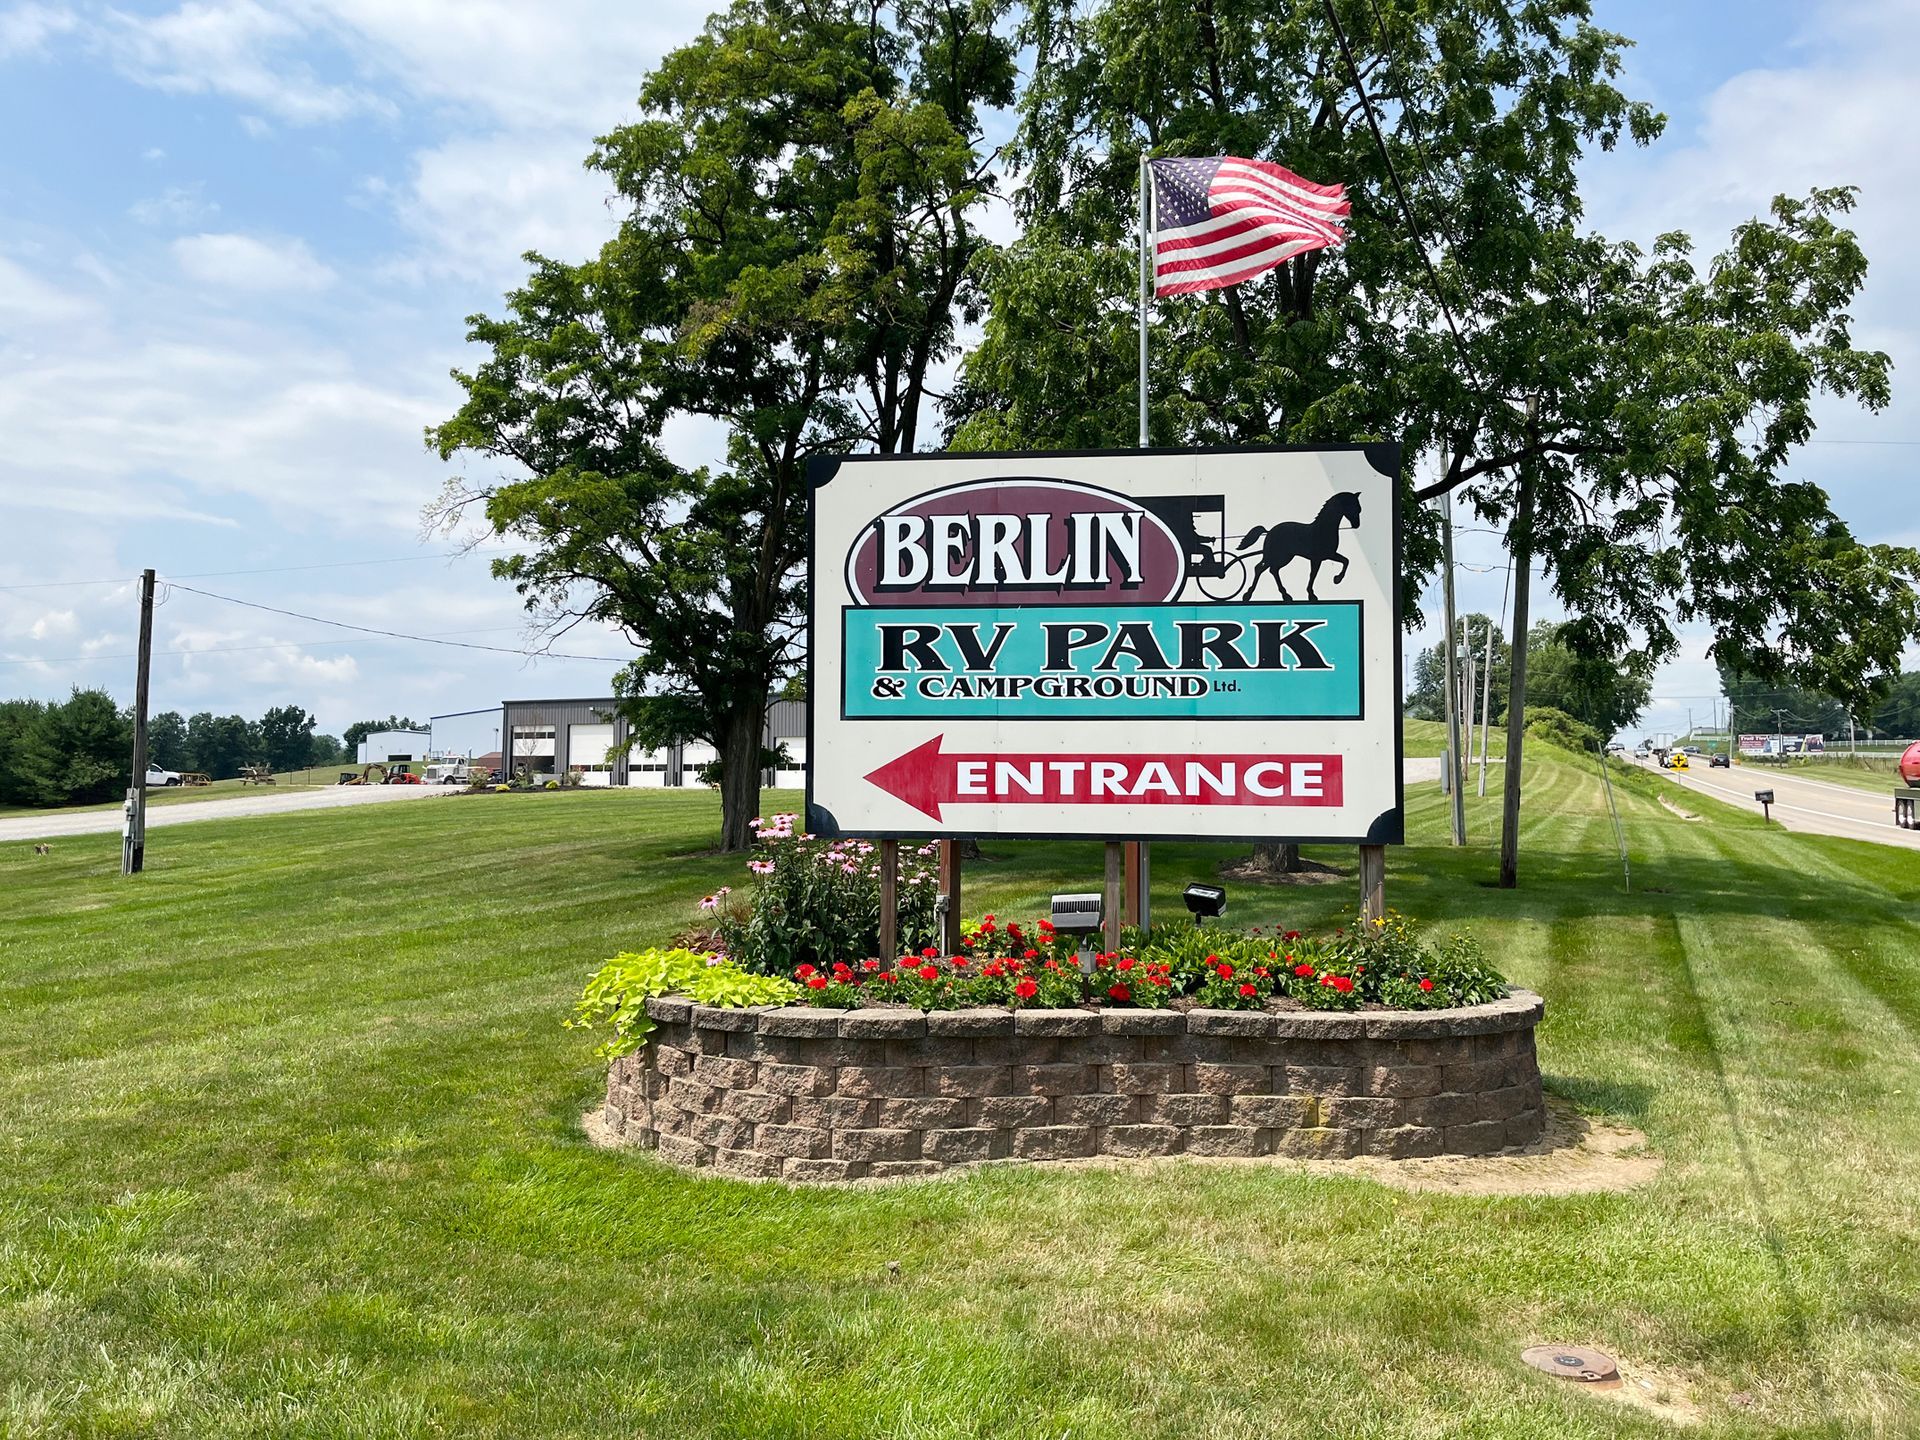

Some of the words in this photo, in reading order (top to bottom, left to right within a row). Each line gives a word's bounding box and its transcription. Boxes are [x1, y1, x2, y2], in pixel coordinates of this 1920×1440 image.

[874, 511, 1145, 595] BERLIN
[876, 622, 1016, 673] RV
[1040, 620, 1335, 672] PARK
[871, 676, 904, 699] &
[917, 675, 1210, 699] CAMPGROUND
[1213, 680, 1242, 692] Ltd.
[956, 761, 1324, 797] ENTRANCE
